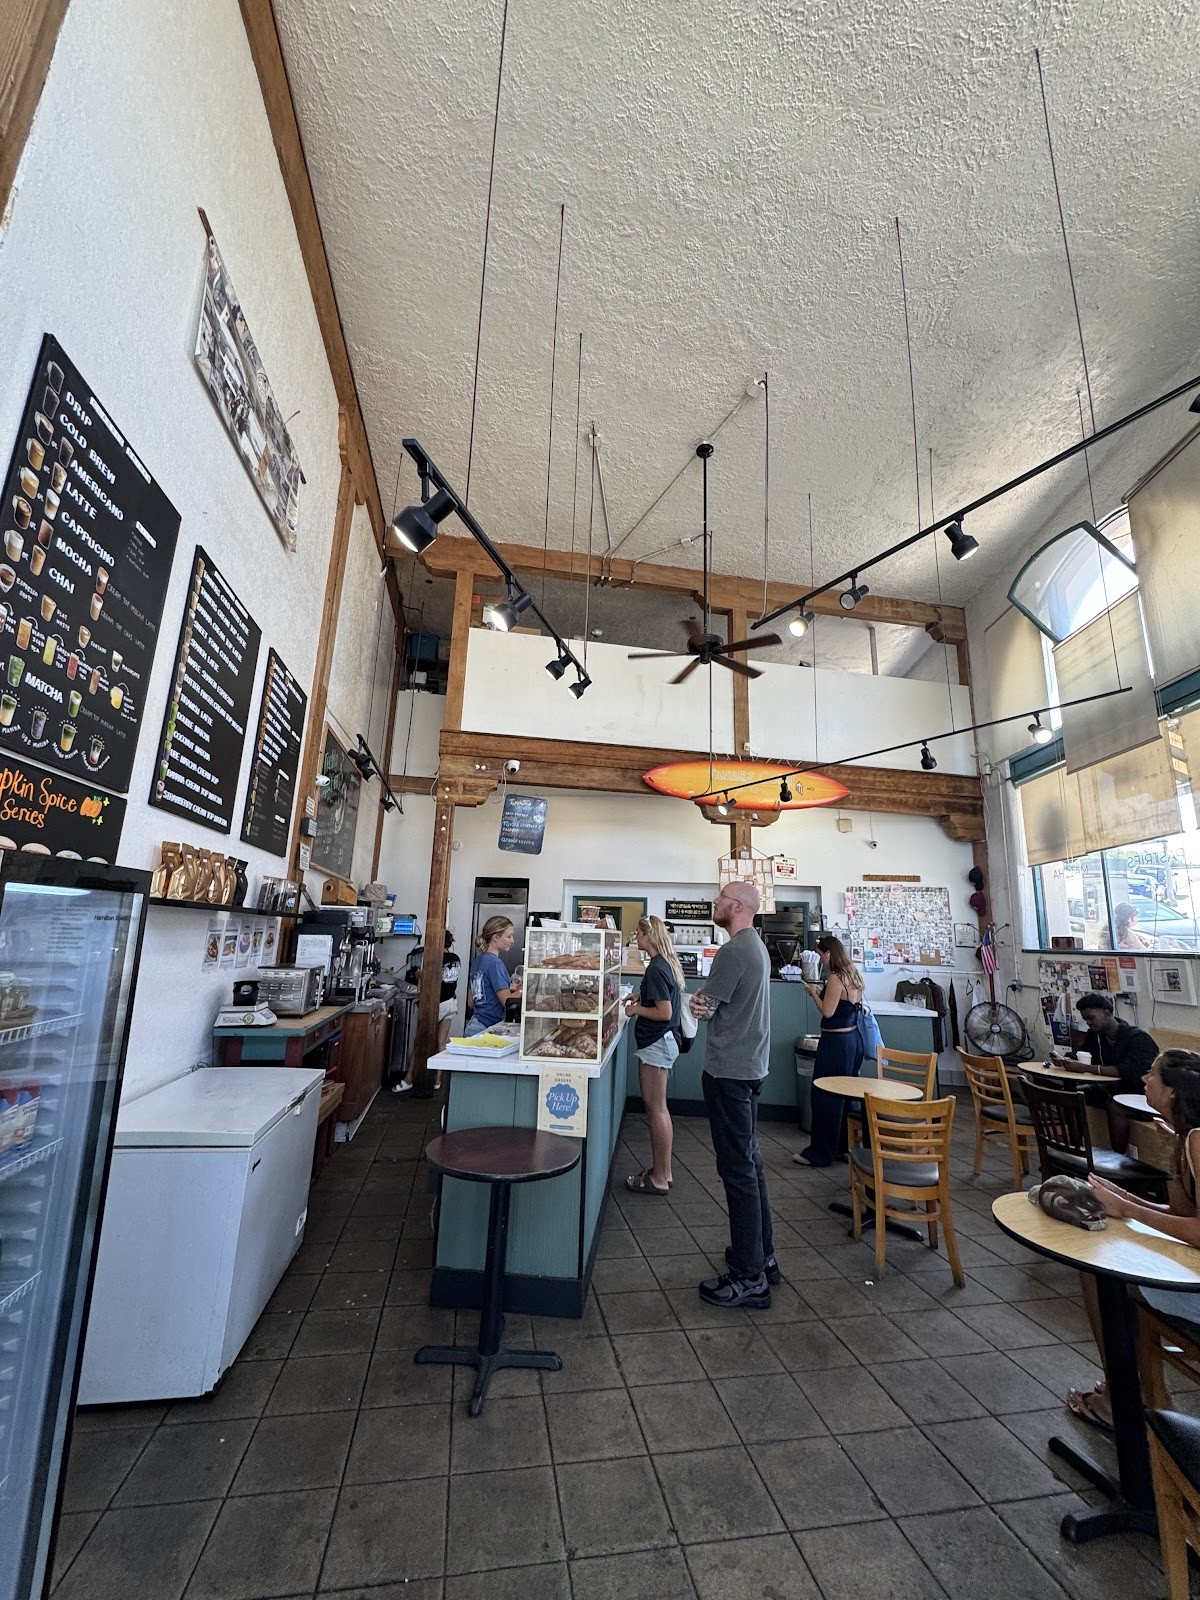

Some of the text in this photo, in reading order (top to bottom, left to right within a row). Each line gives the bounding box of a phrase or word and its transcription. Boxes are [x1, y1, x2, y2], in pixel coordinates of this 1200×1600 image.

[66, 392, 92, 425] DRIP
[60, 414, 115, 484] COLD BREW
[66, 482, 97, 519] LATTE
[70, 460, 123, 520] AMERICANO
[61, 512, 114, 566] CAPPUCINO
[56, 538, 91, 576] MOCHA
[49, 568, 74, 593] CHAI
[220, 595, 230, 610] COLD
[5, 624, 14, 634] TEA
[31, 645, 40, 653] TEA
[207, 656, 219, 672] LATTE
[25, 672, 63, 703] MATCHA
[177, 712, 194, 729] DOUBLE
[200, 711, 213, 726] LATTE
[39, 778, 77, 814] Spice
[0, 798, 45, 828] Series
[548, 1092, 578, 1108] Pick Up
